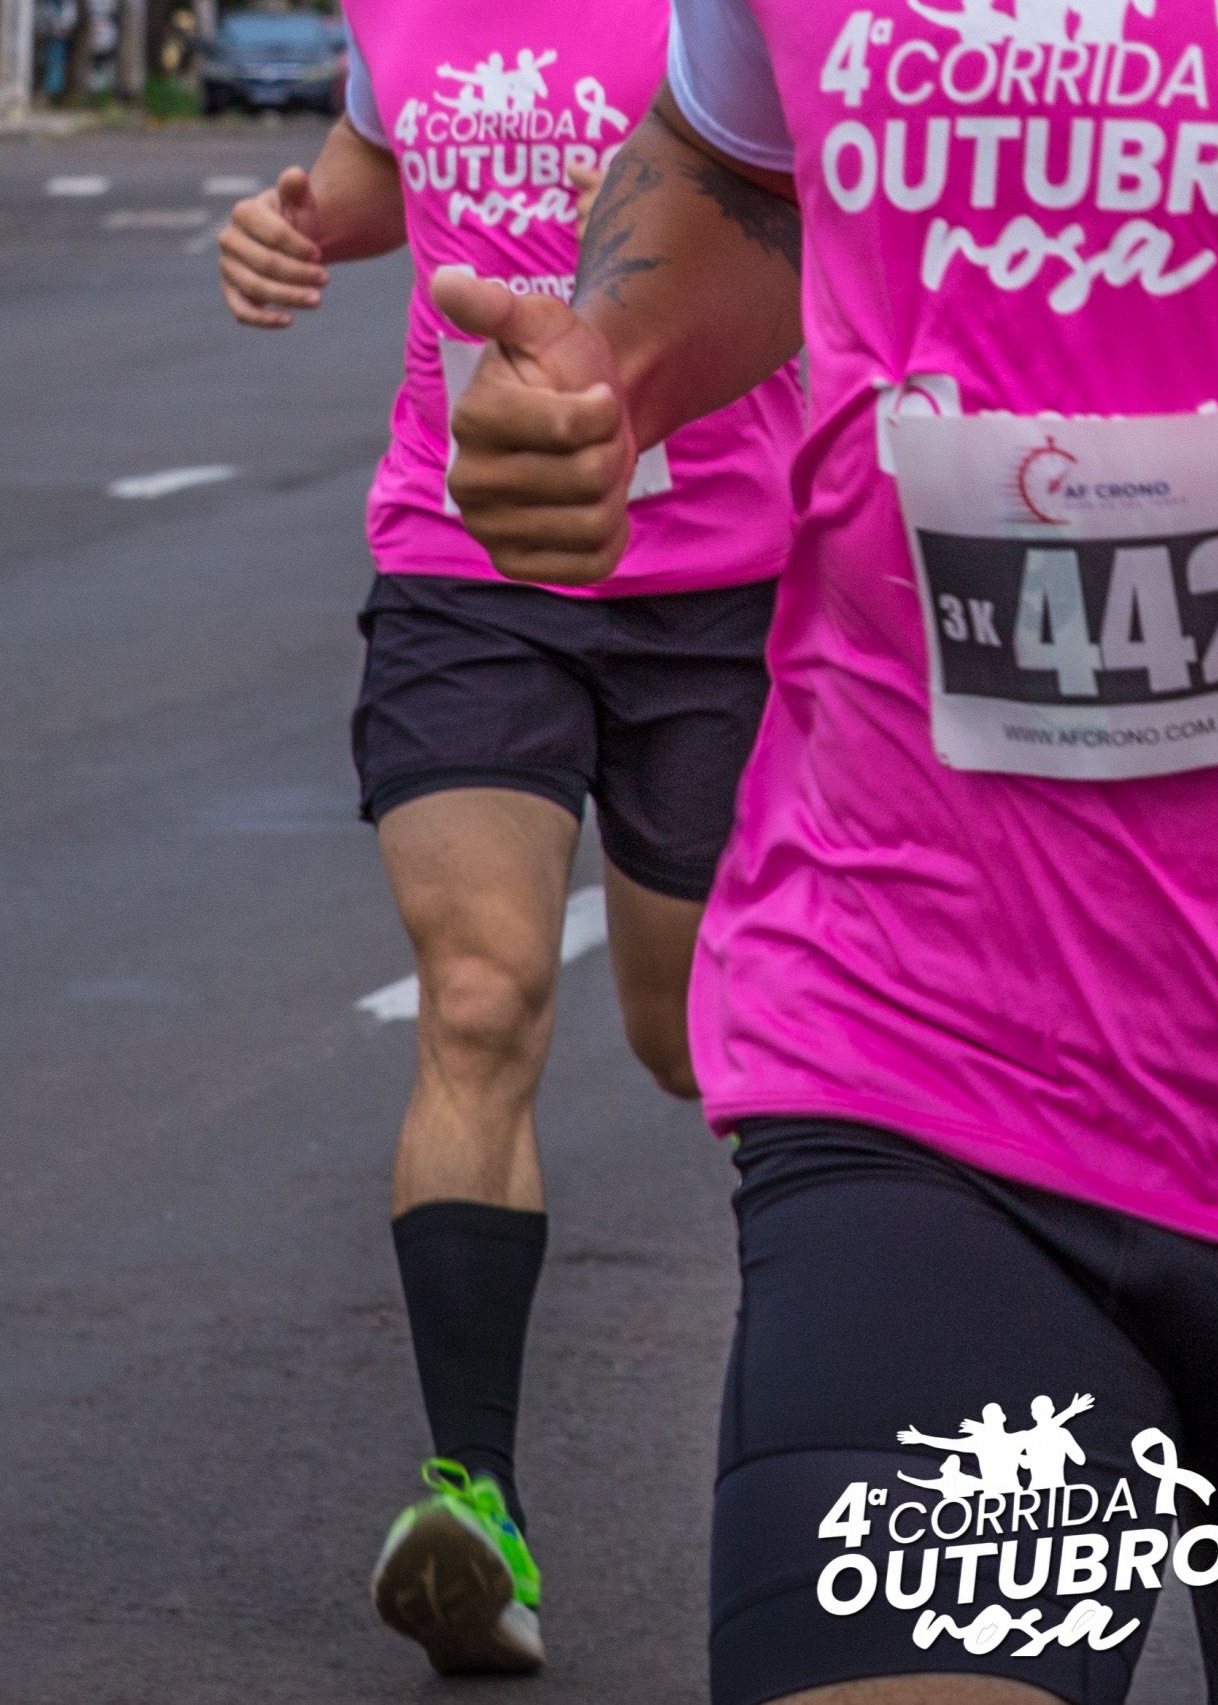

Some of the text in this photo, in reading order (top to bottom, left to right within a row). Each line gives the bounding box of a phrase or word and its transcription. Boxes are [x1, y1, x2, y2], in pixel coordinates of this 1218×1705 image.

[886, 39, 1210, 109] CORRIDA
[425, 108, 577, 143] CORRIDA
[401, 143, 624, 193] OUTUBR
[447, 188, 579, 237] rosa
[920, 214, 1218, 316] rosa
[1095, 479, 1170, 499] CRONO
[938, 593, 1002, 648] 3K
